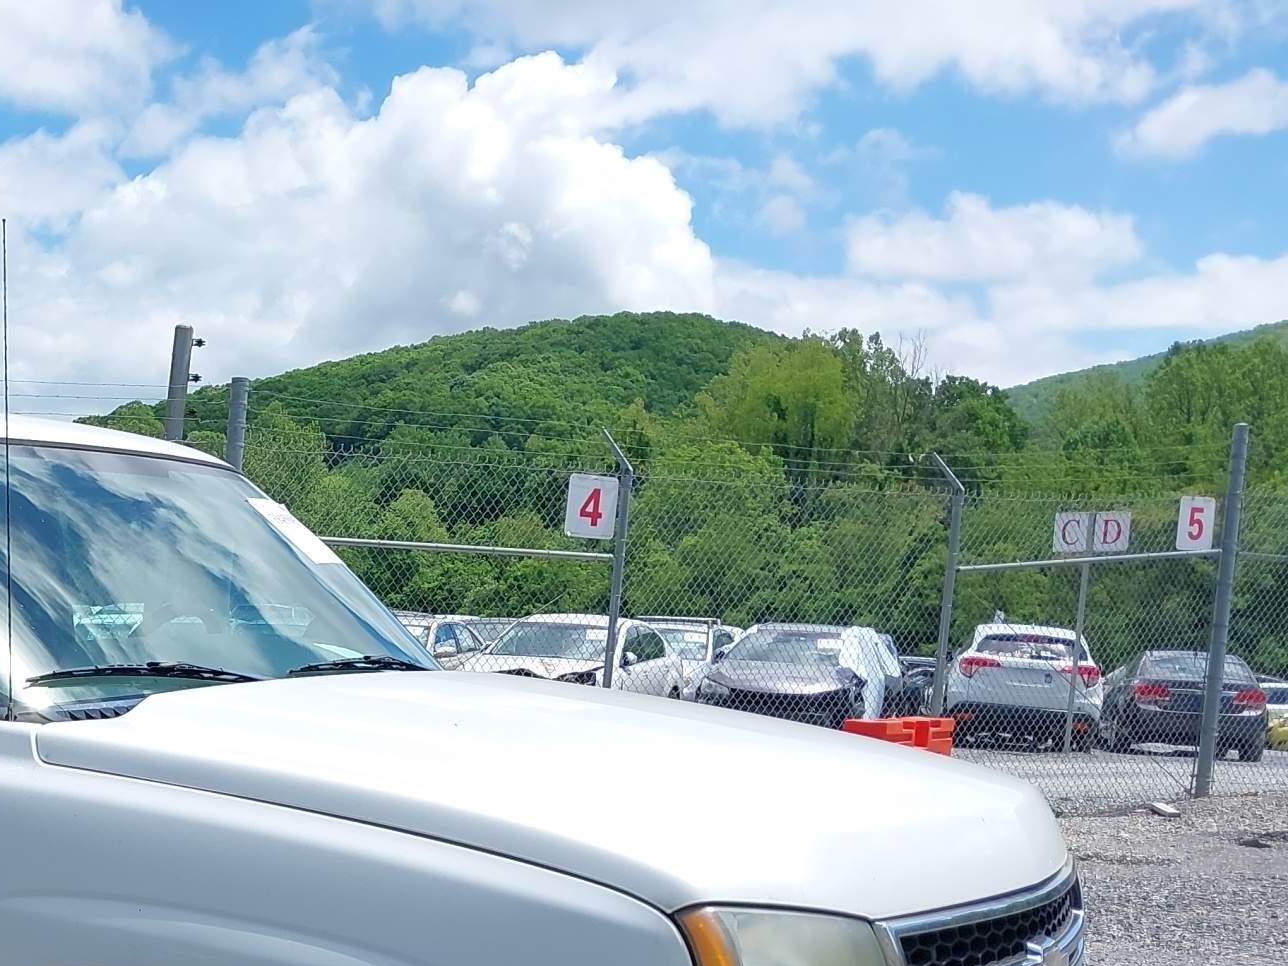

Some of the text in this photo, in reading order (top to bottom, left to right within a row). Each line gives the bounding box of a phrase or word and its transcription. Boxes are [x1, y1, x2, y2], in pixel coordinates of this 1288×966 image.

[579, 487, 603, 527] 4
[1061, 518, 1080, 546] C
[1100, 518, 1122, 545] D
[1187, 506, 1205, 541] 5
